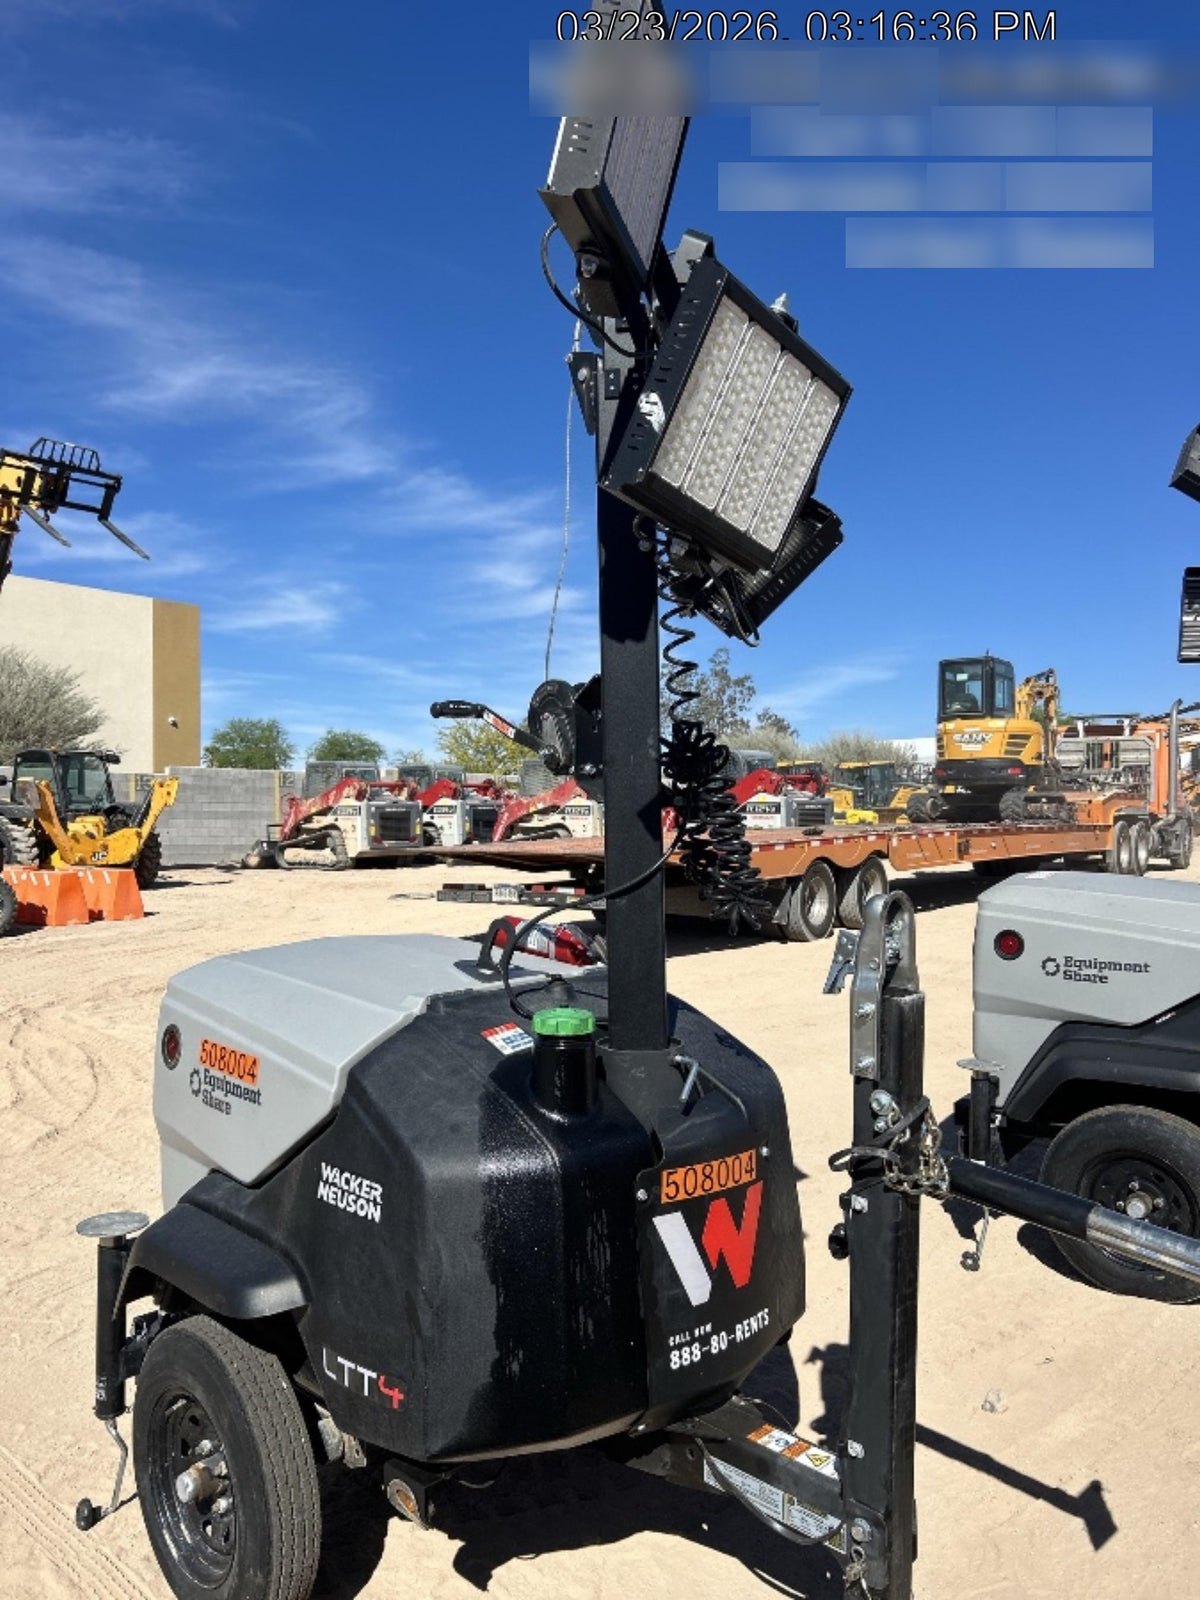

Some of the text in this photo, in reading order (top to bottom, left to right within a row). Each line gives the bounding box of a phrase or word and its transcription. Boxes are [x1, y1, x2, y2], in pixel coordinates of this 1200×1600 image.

[1063, 956, 1151, 973] Equipment
[1063, 970, 1109, 984] Share
[200, 1039, 258, 1084] 508004
[202, 1088, 232, 1116] Share
[204, 1068, 262, 1106] Equipment
[321, 1162, 383, 1204] WACKER
[665, 1151, 756, 1201] 508004
[317, 1180, 382, 1224] NEUSON
[669, 1308, 769, 1370] 888-80-RENTS
[322, 1347, 404, 1410] LTT4
